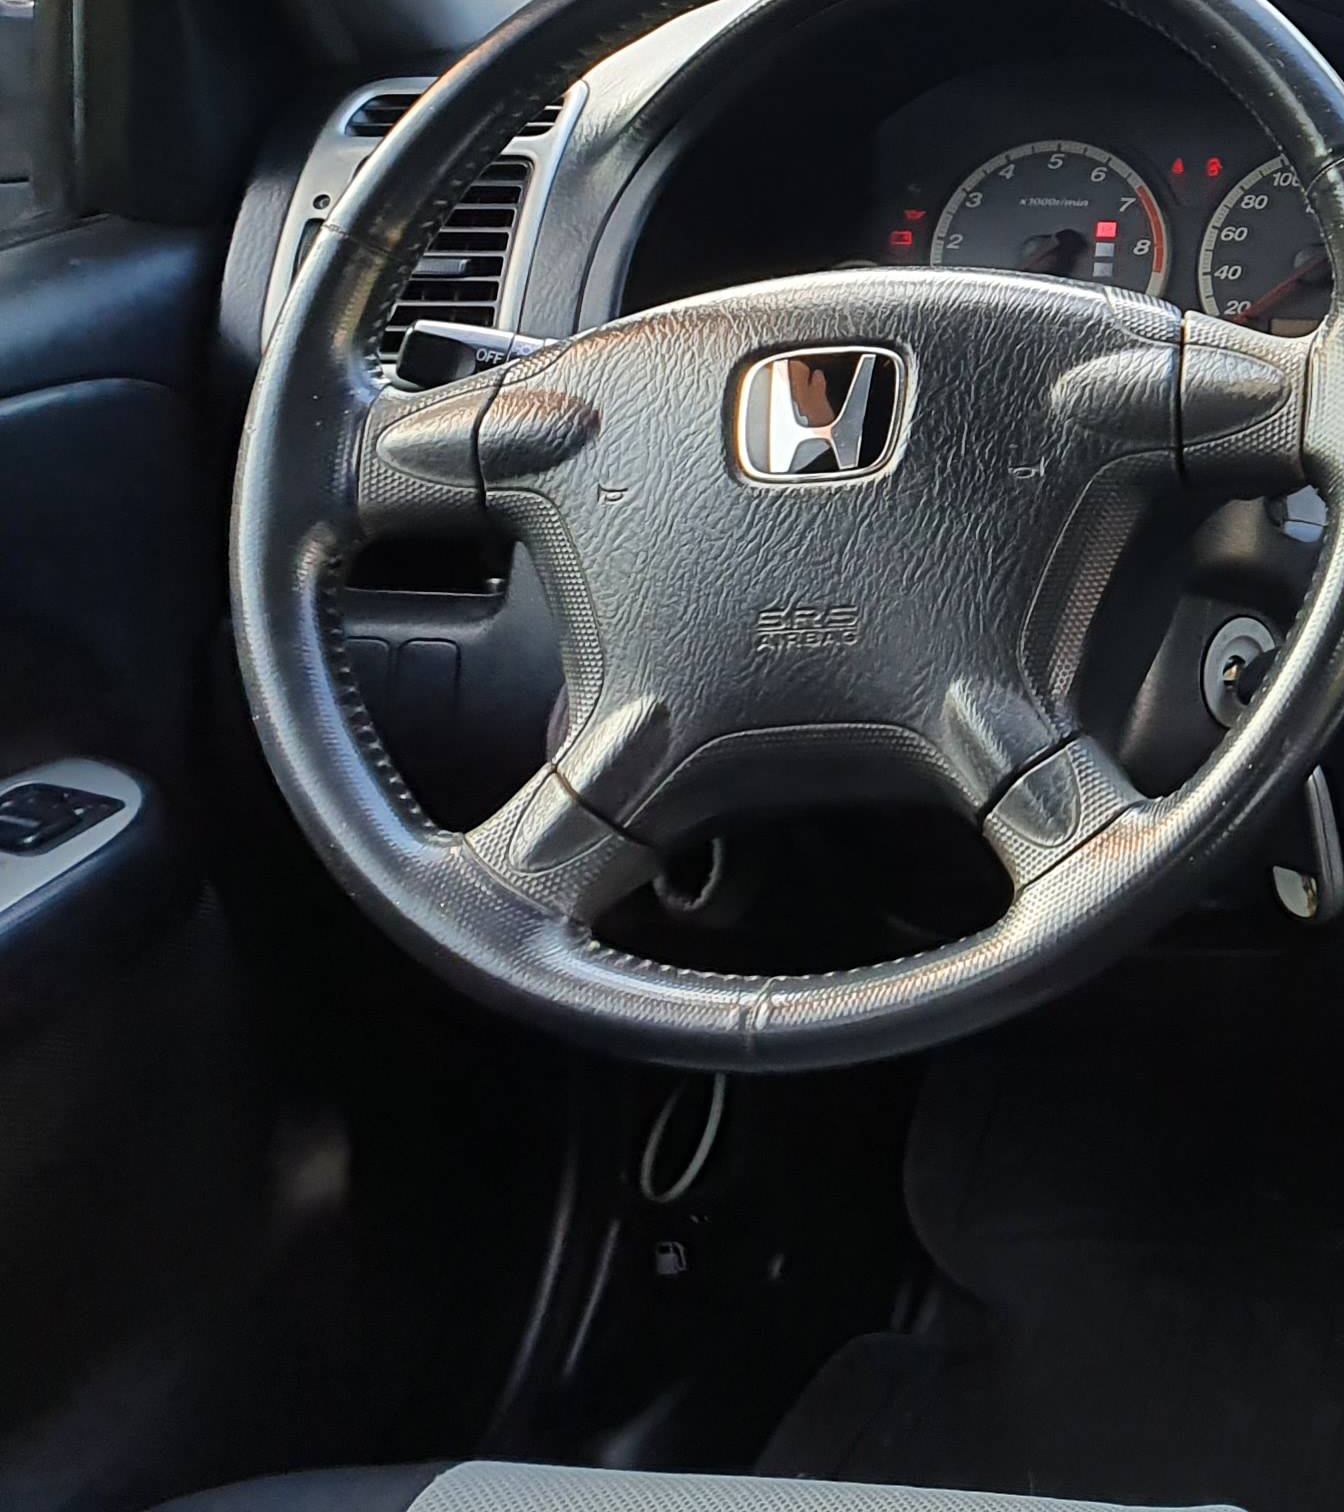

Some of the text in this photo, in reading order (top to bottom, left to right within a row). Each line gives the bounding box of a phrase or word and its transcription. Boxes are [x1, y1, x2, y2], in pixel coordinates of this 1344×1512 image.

[1048, 153, 1065, 170] 5
[998, 163, 1016, 179] 4
[1090, 166, 1108, 182] 6
[965, 192, 983, 208] 3
[1119, 197, 1136, 212] 7
[1240, 195, 1268, 209] 80
[946, 234, 964, 249] 2
[1220, 227, 1248, 241] 60
[1133, 239, 1151, 256] 8
[1214, 265, 1242, 280] 40
[1224, 301, 1252, 316] 20
[475, 348, 505, 364] OFF
[758, 604, 858, 629] SRS
[757, 631, 858, 650] AIRBAG
